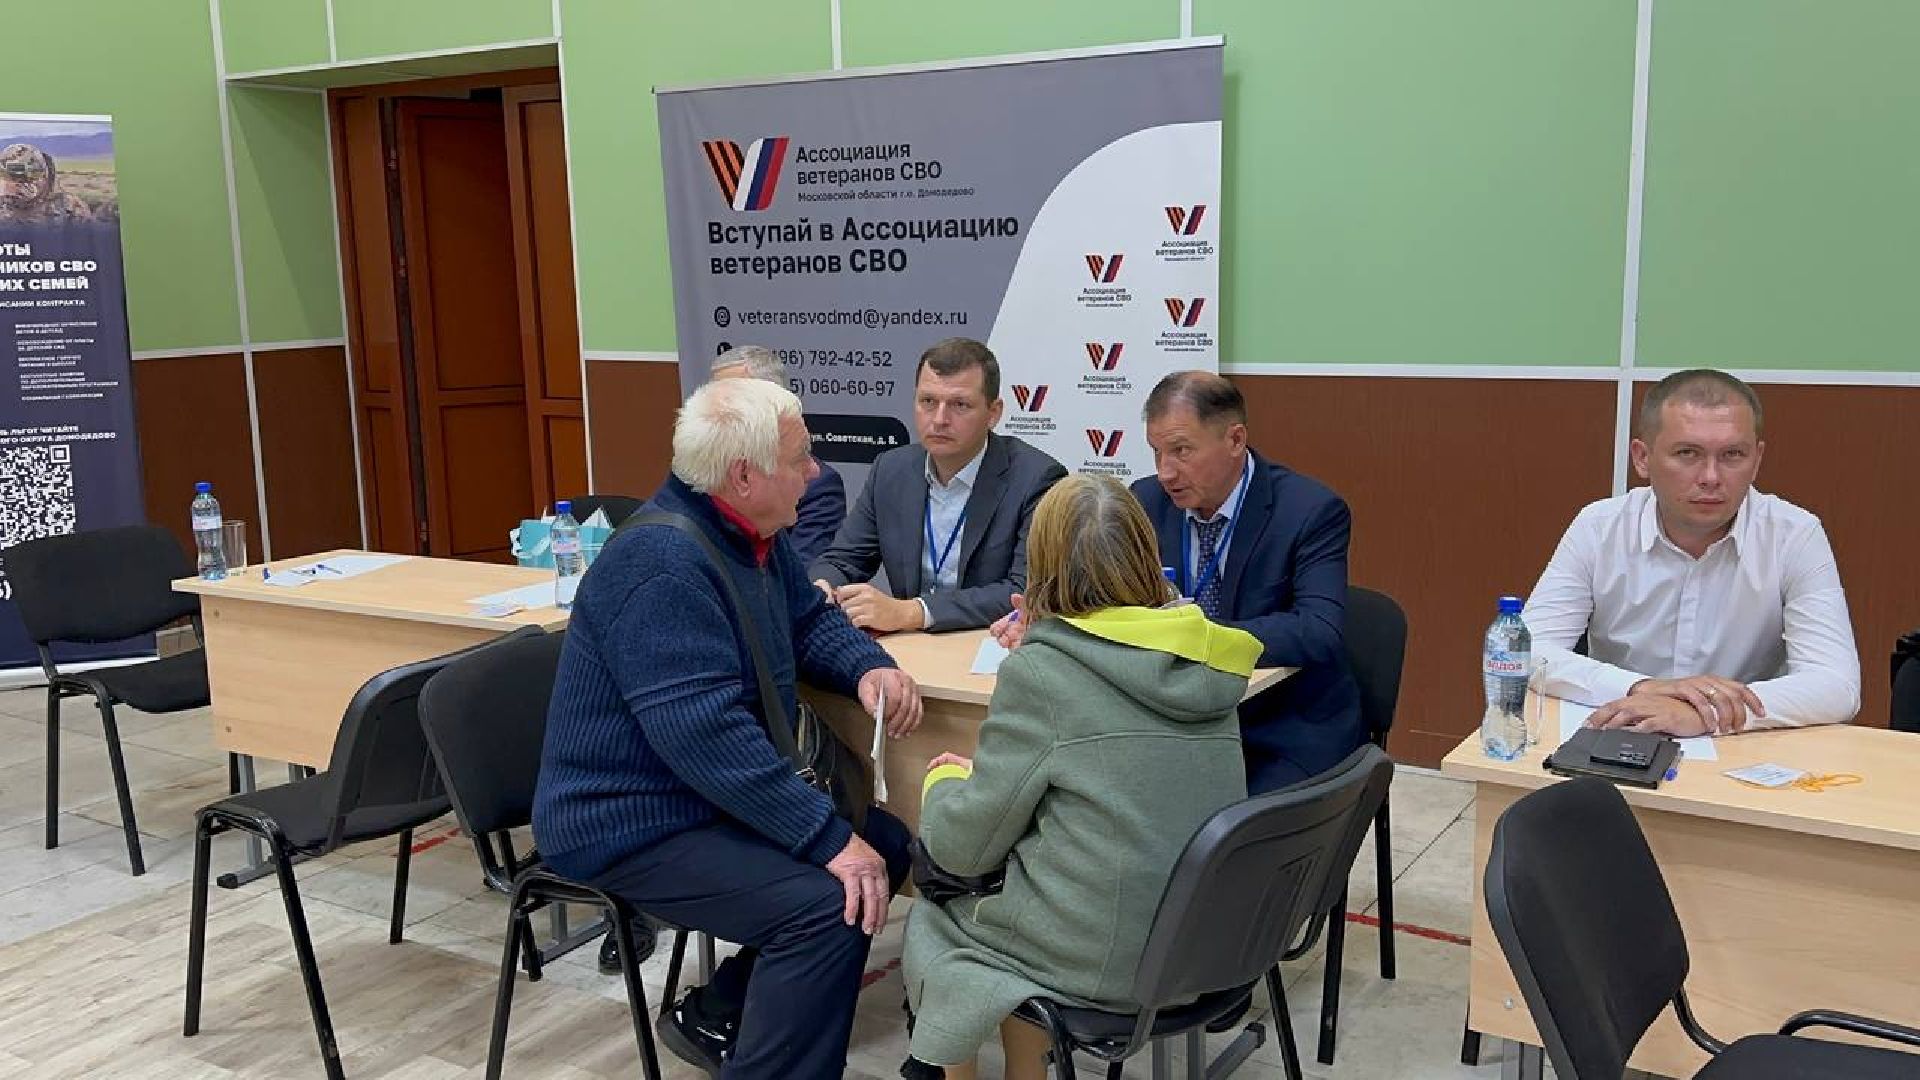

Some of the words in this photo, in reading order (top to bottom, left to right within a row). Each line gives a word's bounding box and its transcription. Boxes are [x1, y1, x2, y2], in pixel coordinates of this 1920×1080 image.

[795, 143, 911, 163] Ассоциация
[797, 166, 895, 187] ветеранов
[900, 160, 943, 181] СВО
[797, 190, 856, 202] Московской
[857, 189, 898, 200] области
[917, 187, 976, 199] Домодедово
[708, 218, 812, 249] Вступай
[820, 225, 834, 241] в
[842, 216, 1019, 243] Ассоциацию
[60, 260, 97, 272] СВО
[710, 253, 842, 279] ветеранов
[850, 248, 908, 273] СВО
[29, 276, 89, 290] СЕМЕЙ
[36, 299, 86, 307] КОНТРАКТА
[738, 307, 968, 330] veteransvodmd@yandex.ru
[772, 350, 805, 369] 96)
[807, 350, 893, 367] 792-42-52
[809, 378, 895, 397] 060-60-97
[54, 431, 116, 441] ДОМОДЕДОВО
